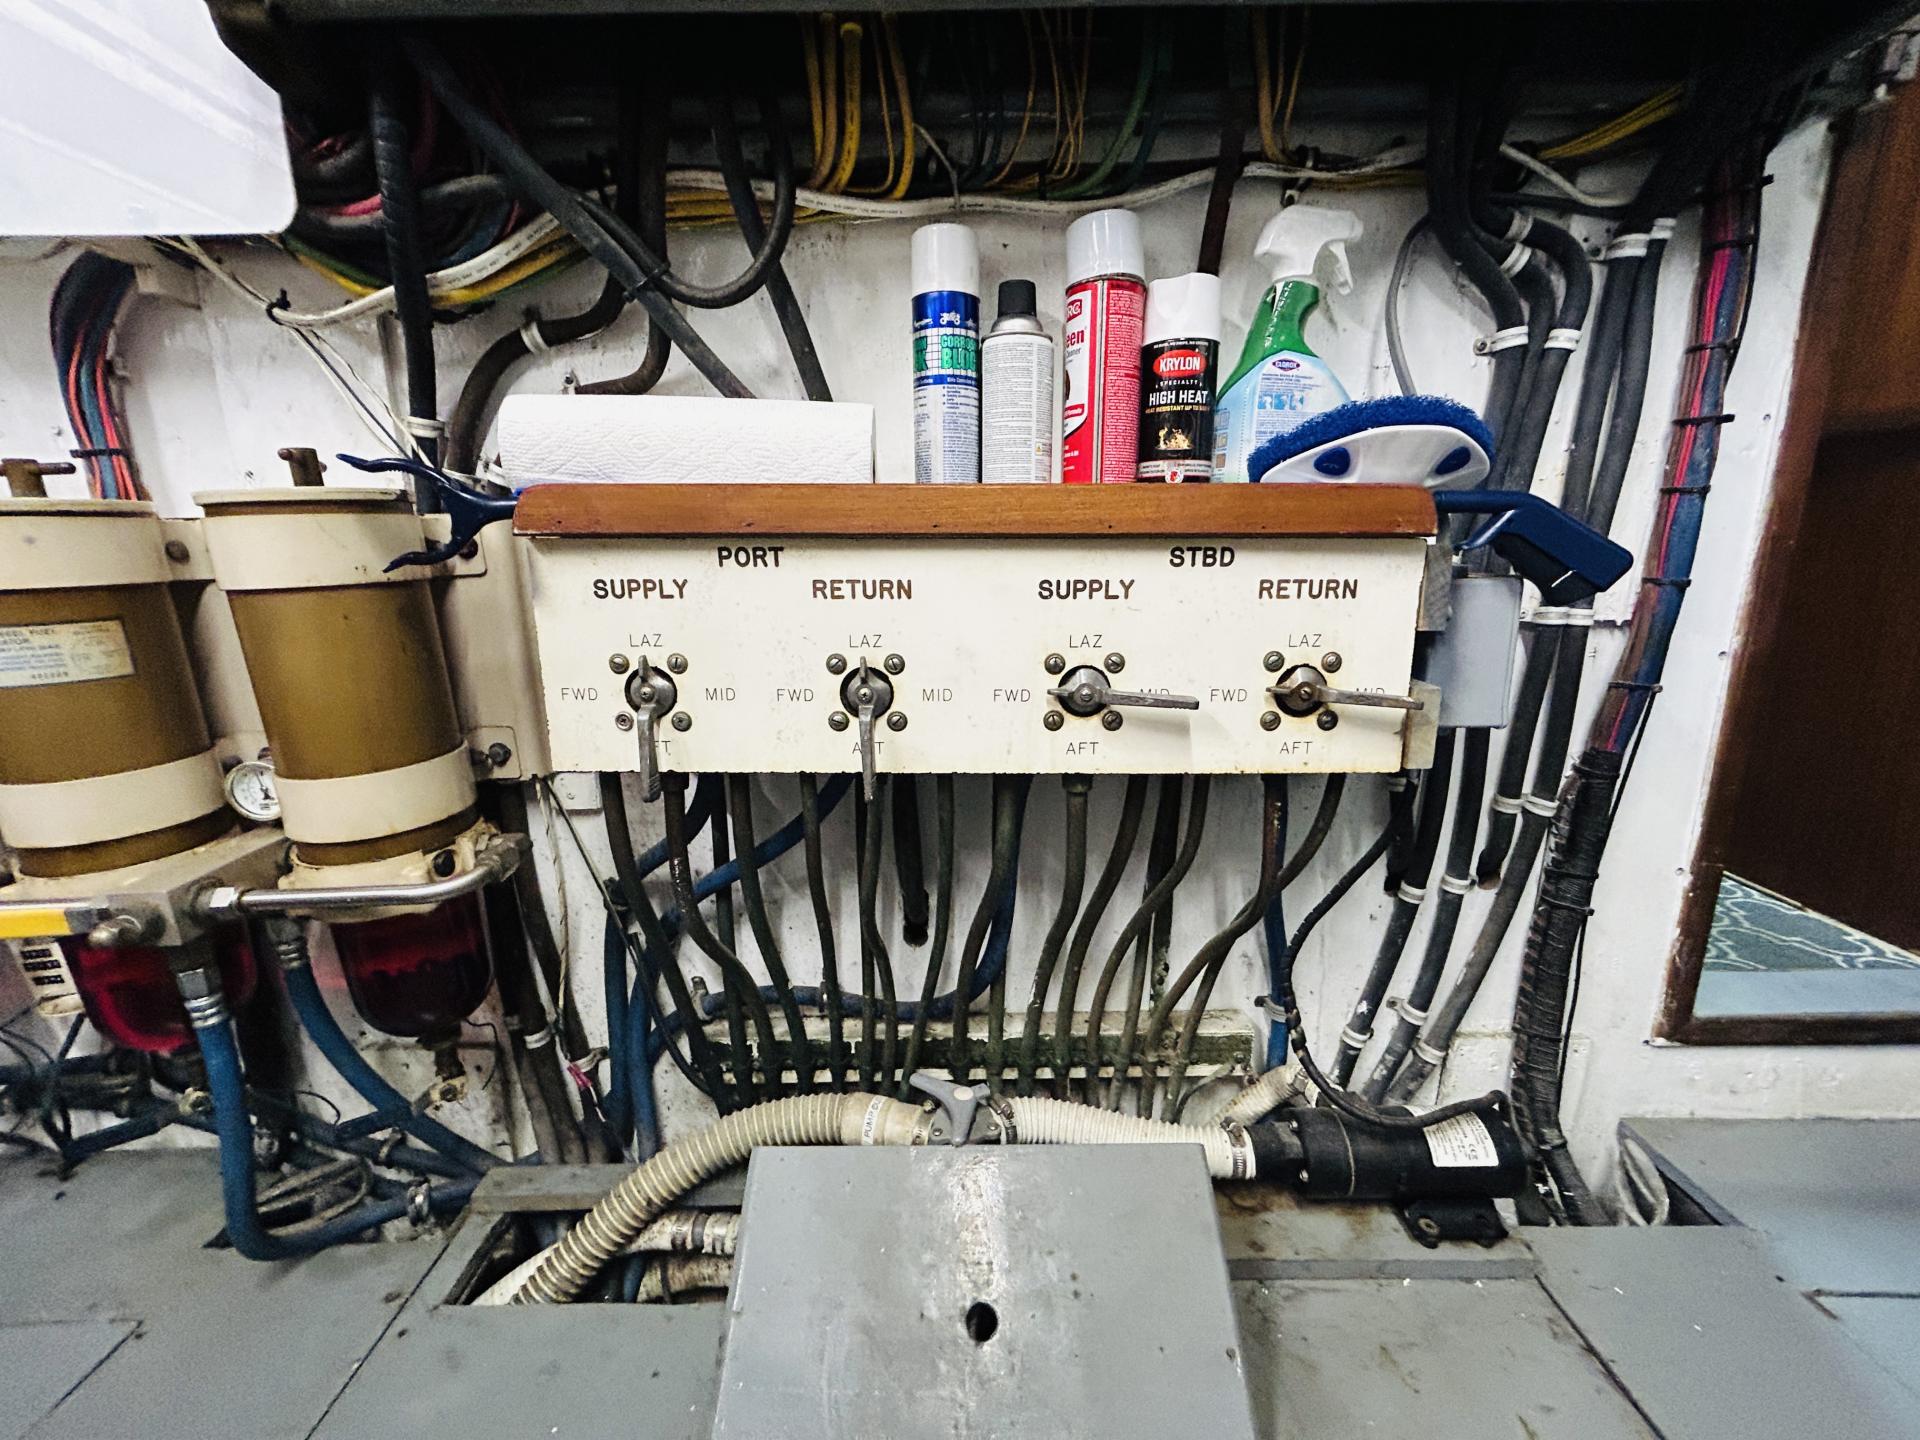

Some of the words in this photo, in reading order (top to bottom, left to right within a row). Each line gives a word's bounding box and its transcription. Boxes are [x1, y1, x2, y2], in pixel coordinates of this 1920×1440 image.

[1159, 356, 1201, 372] KRYLON
[1275, 361, 1297, 369] CLOROX
[1159, 379, 1199, 387] SPECIALTY
[1149, 391, 1177, 406] HIGH
[1179, 390, 1209, 404] HEAT
[717, 547, 784, 567] PORT
[1170, 547, 1234, 567] STBD
[593, 579, 688, 600] SUPPLY
[812, 579, 912, 600] RETURN
[1038, 579, 1135, 600] SUPPLY
[1258, 579, 1358, 600] RETURN
[629, 634, 663, 648] LAZ
[849, 634, 883, 648] LAZ
[1069, 635, 1103, 648] LAZ
[1288, 634, 1322, 648] LAZ
[562, 687, 598, 701] FWD
[706, 688, 736, 701] MID
[777, 688, 814, 702] FWD
[923, 689, 953, 702] MID
[994, 689, 1031, 702] FWD
[1210, 688, 1248, 702] FWD
[653, 740, 671, 754] FT
[852, 741, 884, 754] AT
[1066, 741, 1099, 755] AFT
[1280, 741, 1313, 755] AFT
